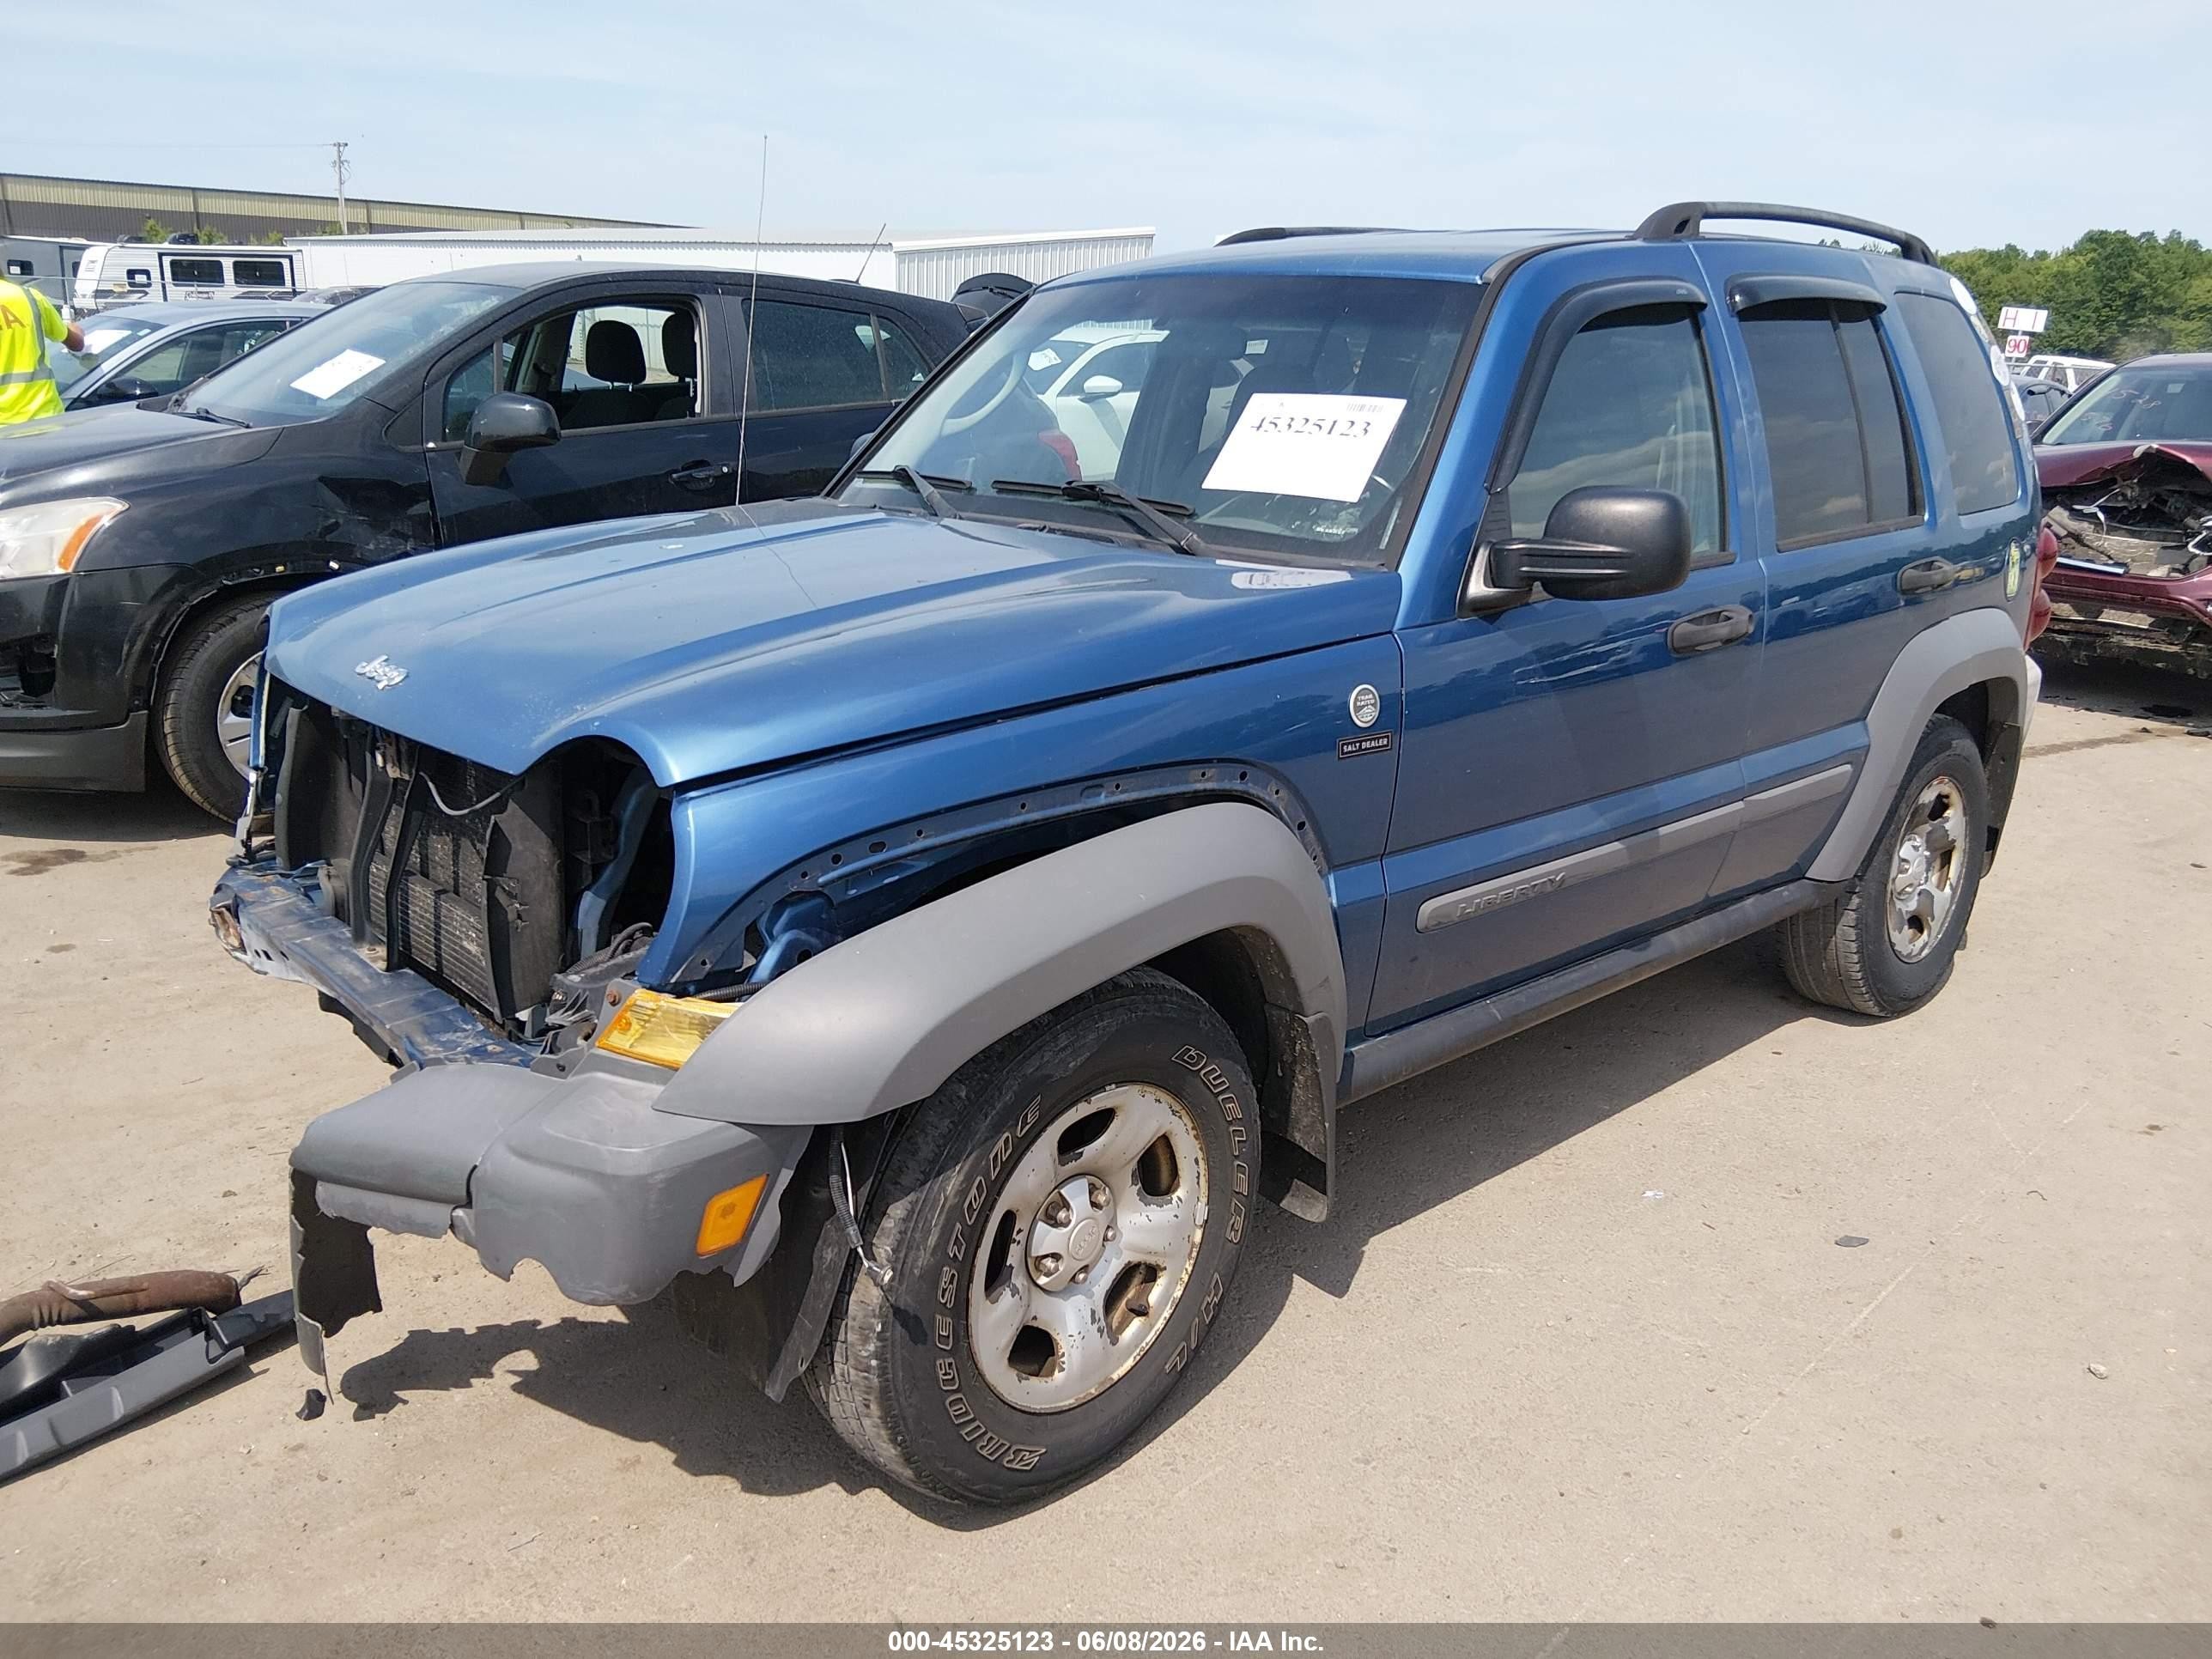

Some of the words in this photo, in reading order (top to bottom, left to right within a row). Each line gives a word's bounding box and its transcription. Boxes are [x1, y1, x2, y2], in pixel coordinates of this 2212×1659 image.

[2002, 308, 2019, 328] H
[2007, 338, 2027, 354] 90
[1250, 416, 1371, 438] 45325123
[1343, 743, 1360, 753] SALT
[1361, 738, 1388, 750] DEALER
[1456, 872, 1565, 916] LIBERTY
[1171, 1044, 1250, 1244] DUELER
[936, 1093, 1048, 1470] BRIDGESTONE
